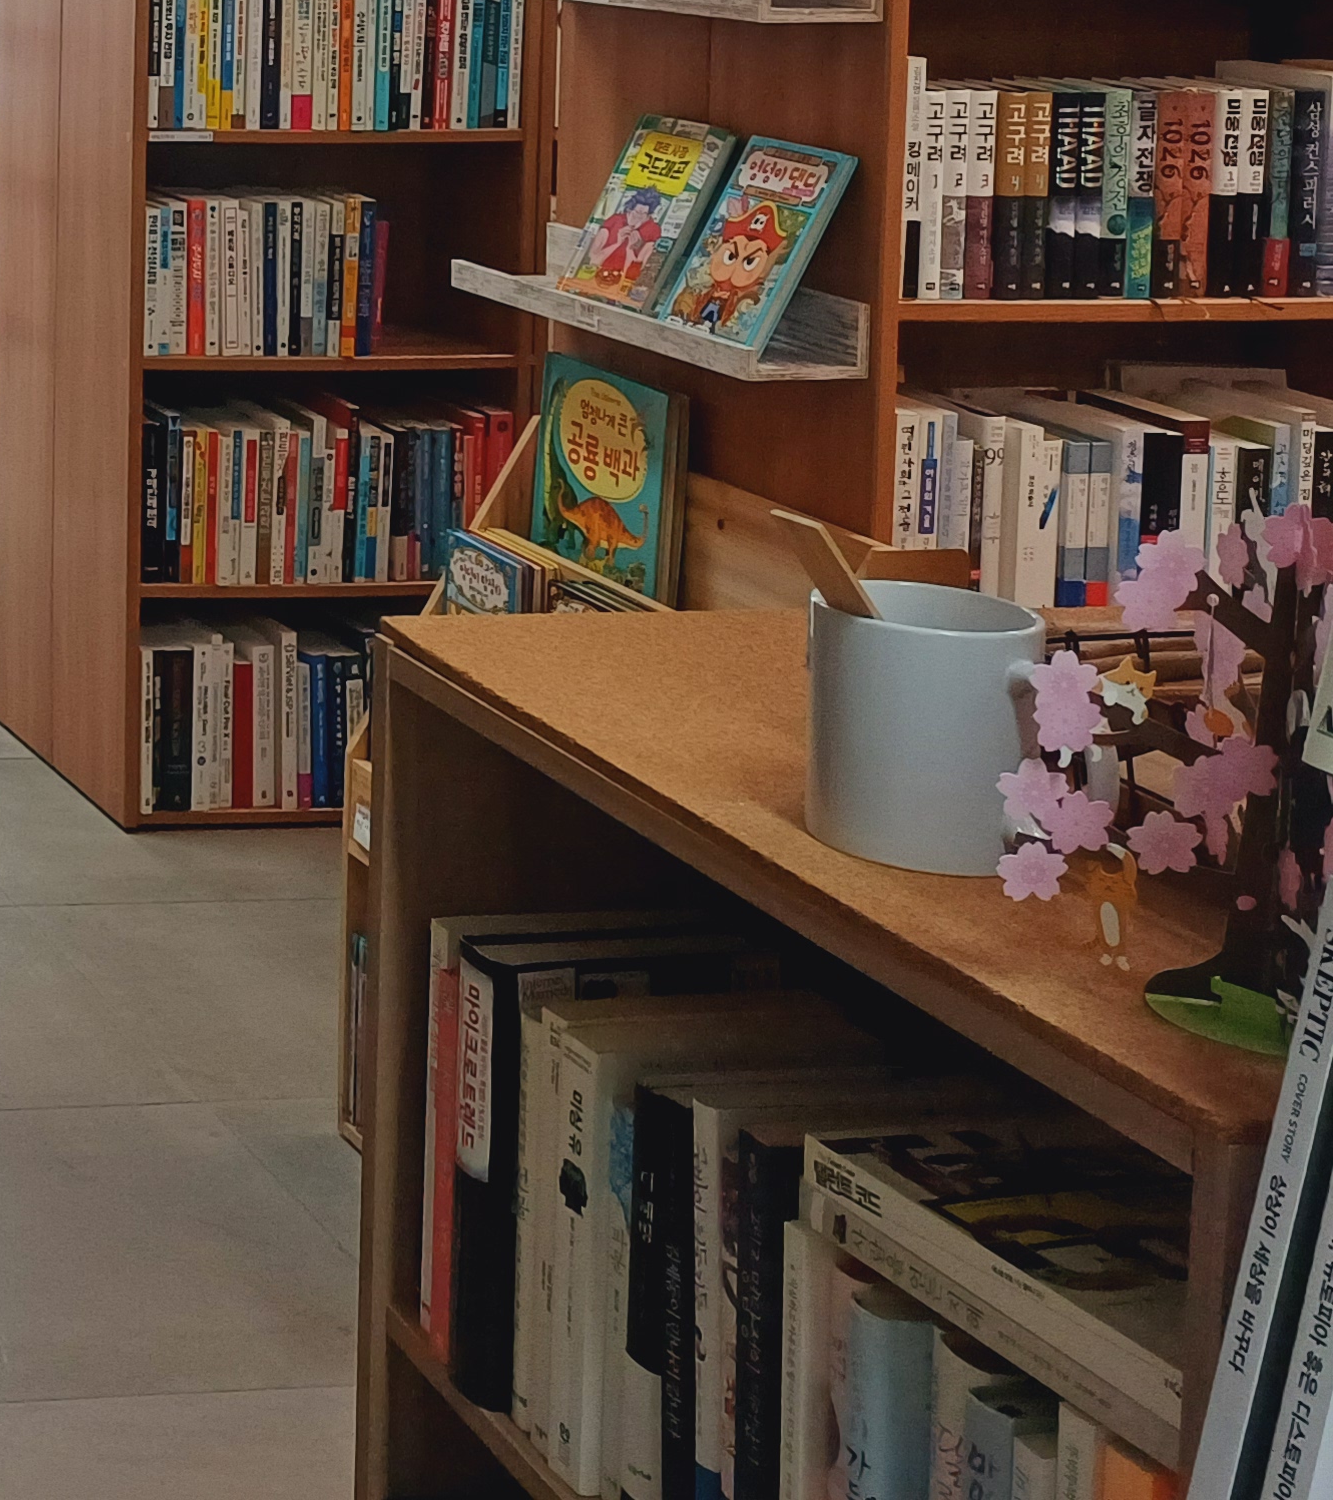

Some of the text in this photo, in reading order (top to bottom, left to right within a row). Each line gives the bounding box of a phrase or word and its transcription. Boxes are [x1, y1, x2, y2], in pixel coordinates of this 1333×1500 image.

[926, 102, 944, 162] 고구려
[948, 101, 968, 188] 고구려 2
[975, 102, 995, 188] 고구려 3
[1007, 103, 1026, 167] 고구려
[1031, 102, 1051, 165] 고구려
[1105, 100, 1130, 212] 최후의 경전
[1162, 120, 1184, 180] 1026
[1189, 121, 1209, 181] 1026
[636, 153, 691, 182] 구드래곤
[905, 141, 921, 211] 킹메이커
[1302, 102, 1321, 231] 삼성 컨스피러시
[580, 399, 629, 438] 엄청나게 큰
[565, 421, 641, 487] 공룡 백과
[984, 448, 1005, 466] 99
[1300, 424, 1313, 480] 마당깊은
[461, 982, 482, 1150] 마이크로트렌드
[1281, 1073, 1308, 1164] COVER STORY
[1228, 1175, 1287, 1375] 상상이 세상을 바꾸다
[1272, 1349, 1320, 1500] 혹은 디스토피아
